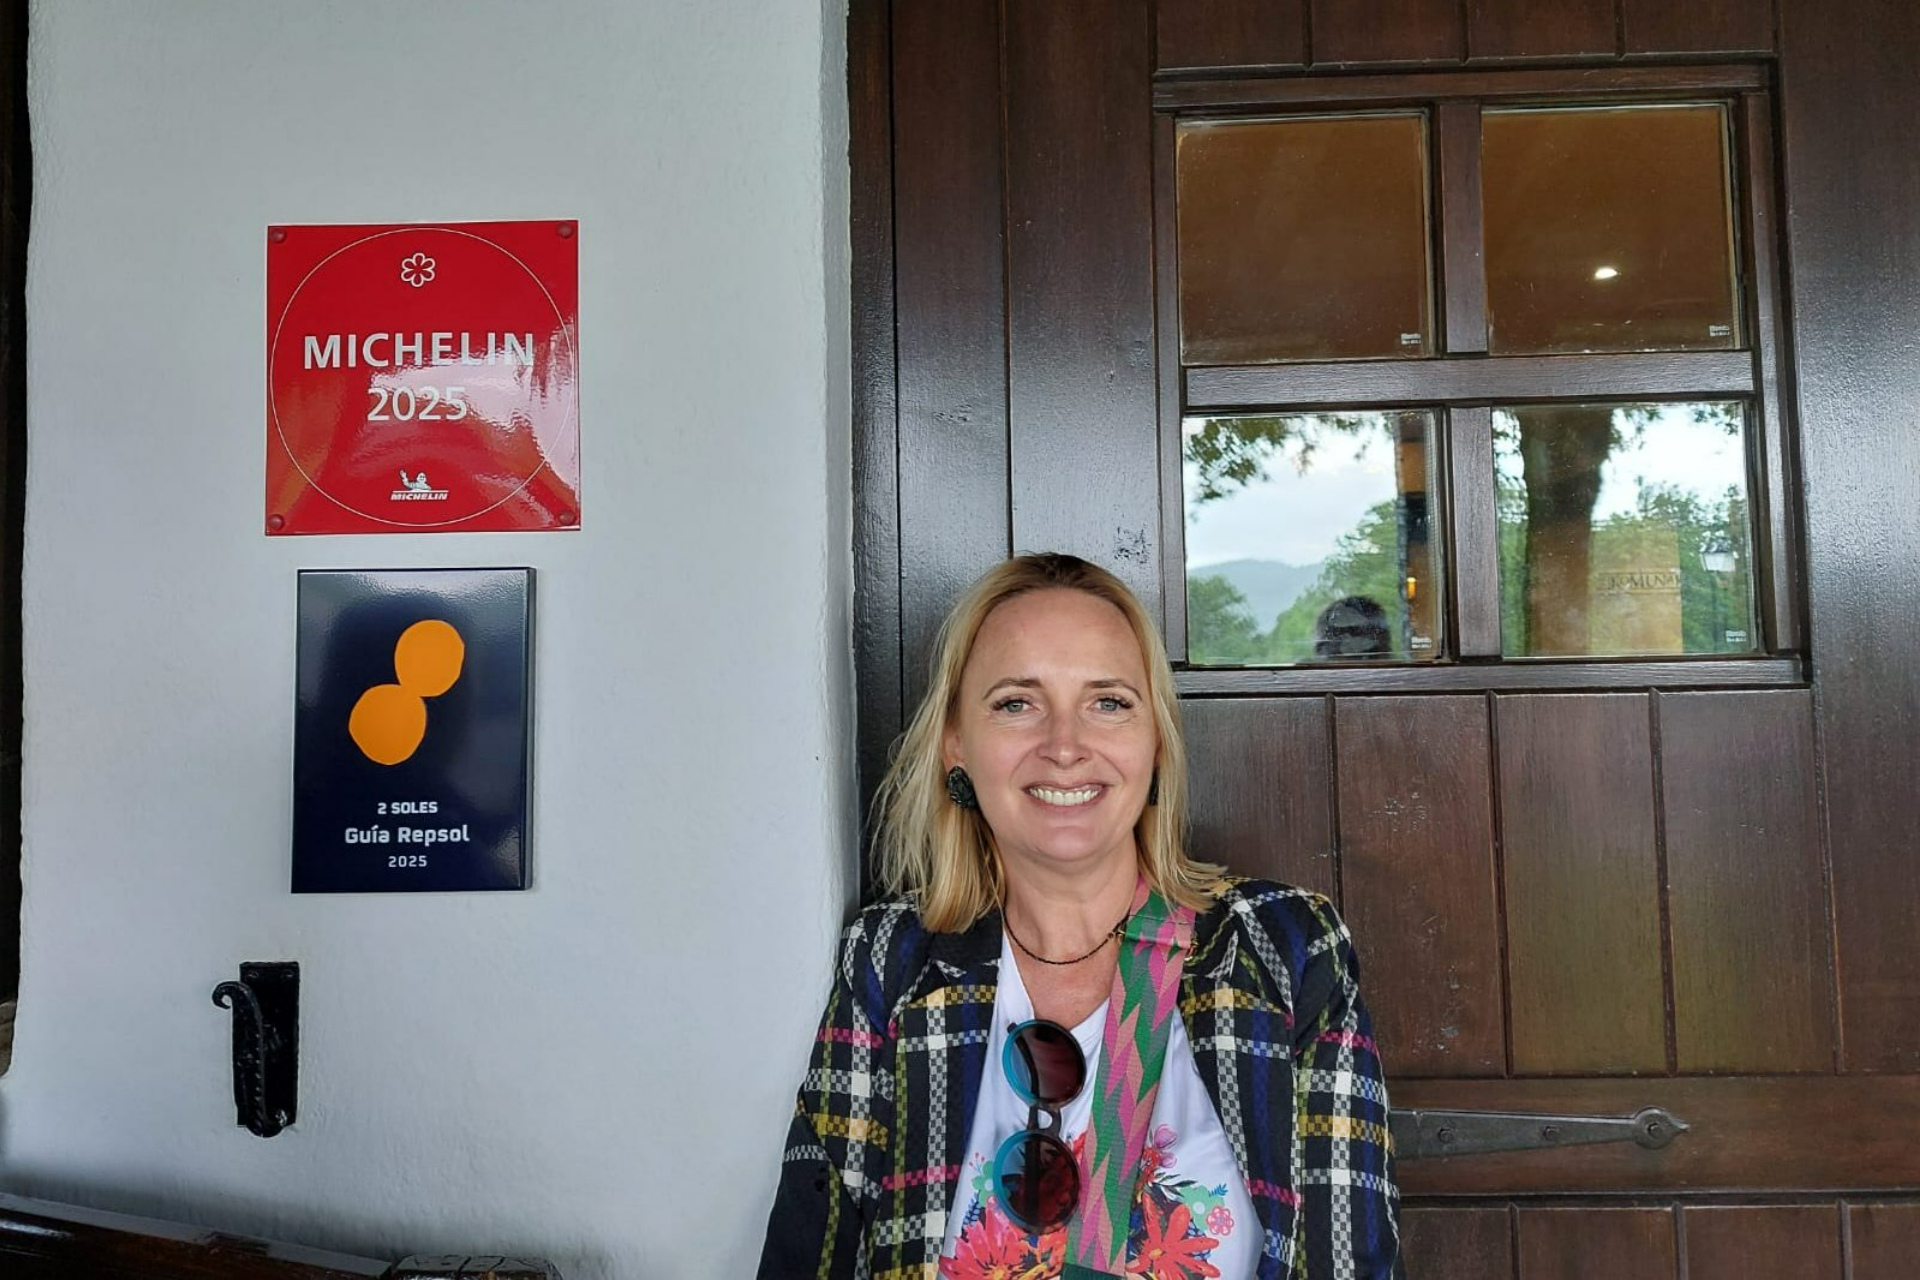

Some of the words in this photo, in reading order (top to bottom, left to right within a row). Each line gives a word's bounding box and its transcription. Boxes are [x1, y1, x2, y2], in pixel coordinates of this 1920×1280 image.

[303, 332, 534, 370] MICHELIN
[367, 385, 468, 422] 2025
[390, 492, 449, 501] MICHELIN
[377, 802, 387, 815] 2
[391, 801, 439, 814] SOLES
[344, 824, 390, 844] Guía
[398, 824, 470, 847] Repsol
[388, 855, 428, 868] 2025
